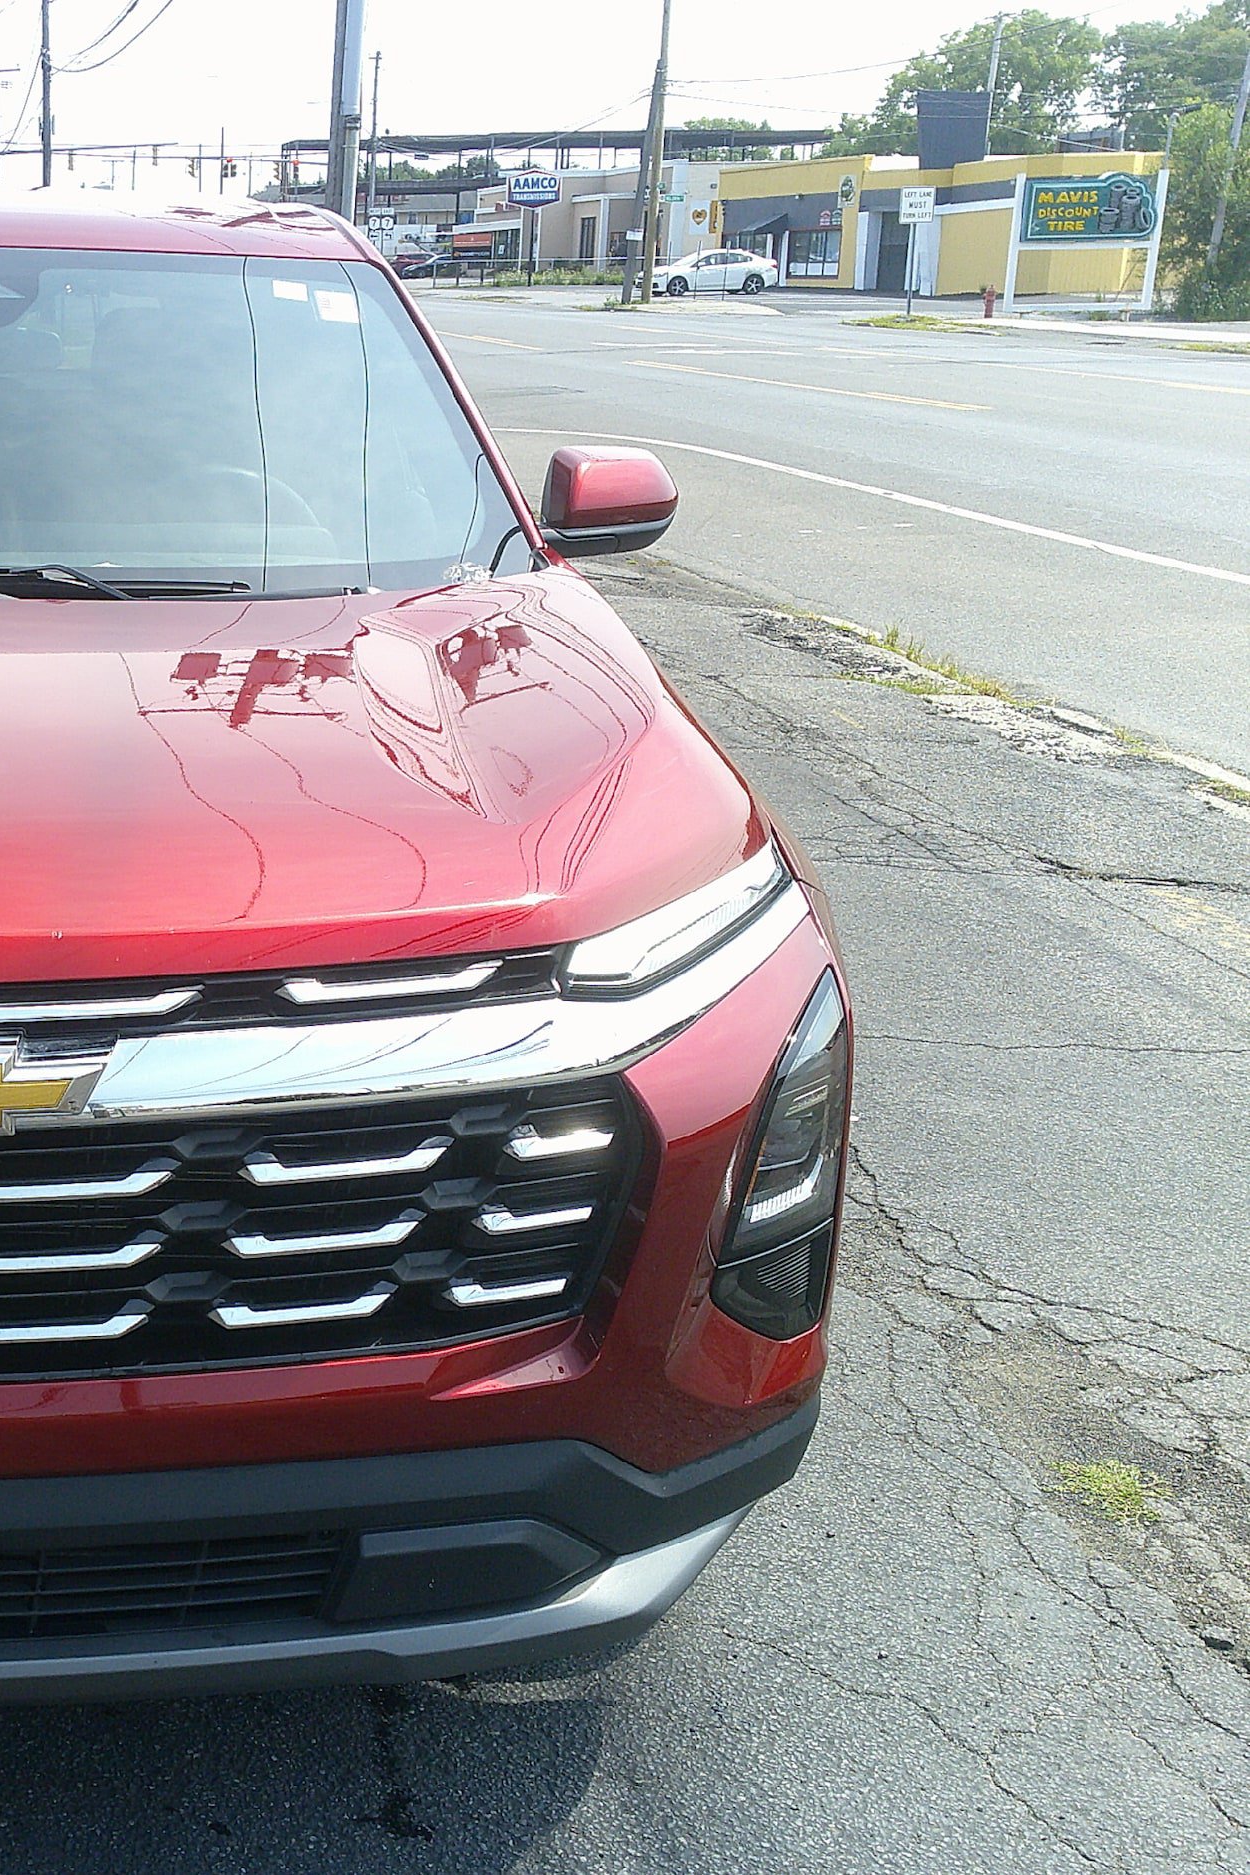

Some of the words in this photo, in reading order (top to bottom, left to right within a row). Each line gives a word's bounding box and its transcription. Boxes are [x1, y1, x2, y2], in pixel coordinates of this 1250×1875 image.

[513, 177, 557, 190] AAMCO
[1038, 191, 1098, 204] MAVIS
[908, 201, 927, 209] MUST
[1038, 206, 1099, 219] DISCOUNT
[371, 218, 377, 227] 7
[384, 218, 391, 228] 7
[1047, 220, 1086, 232] TIRE
